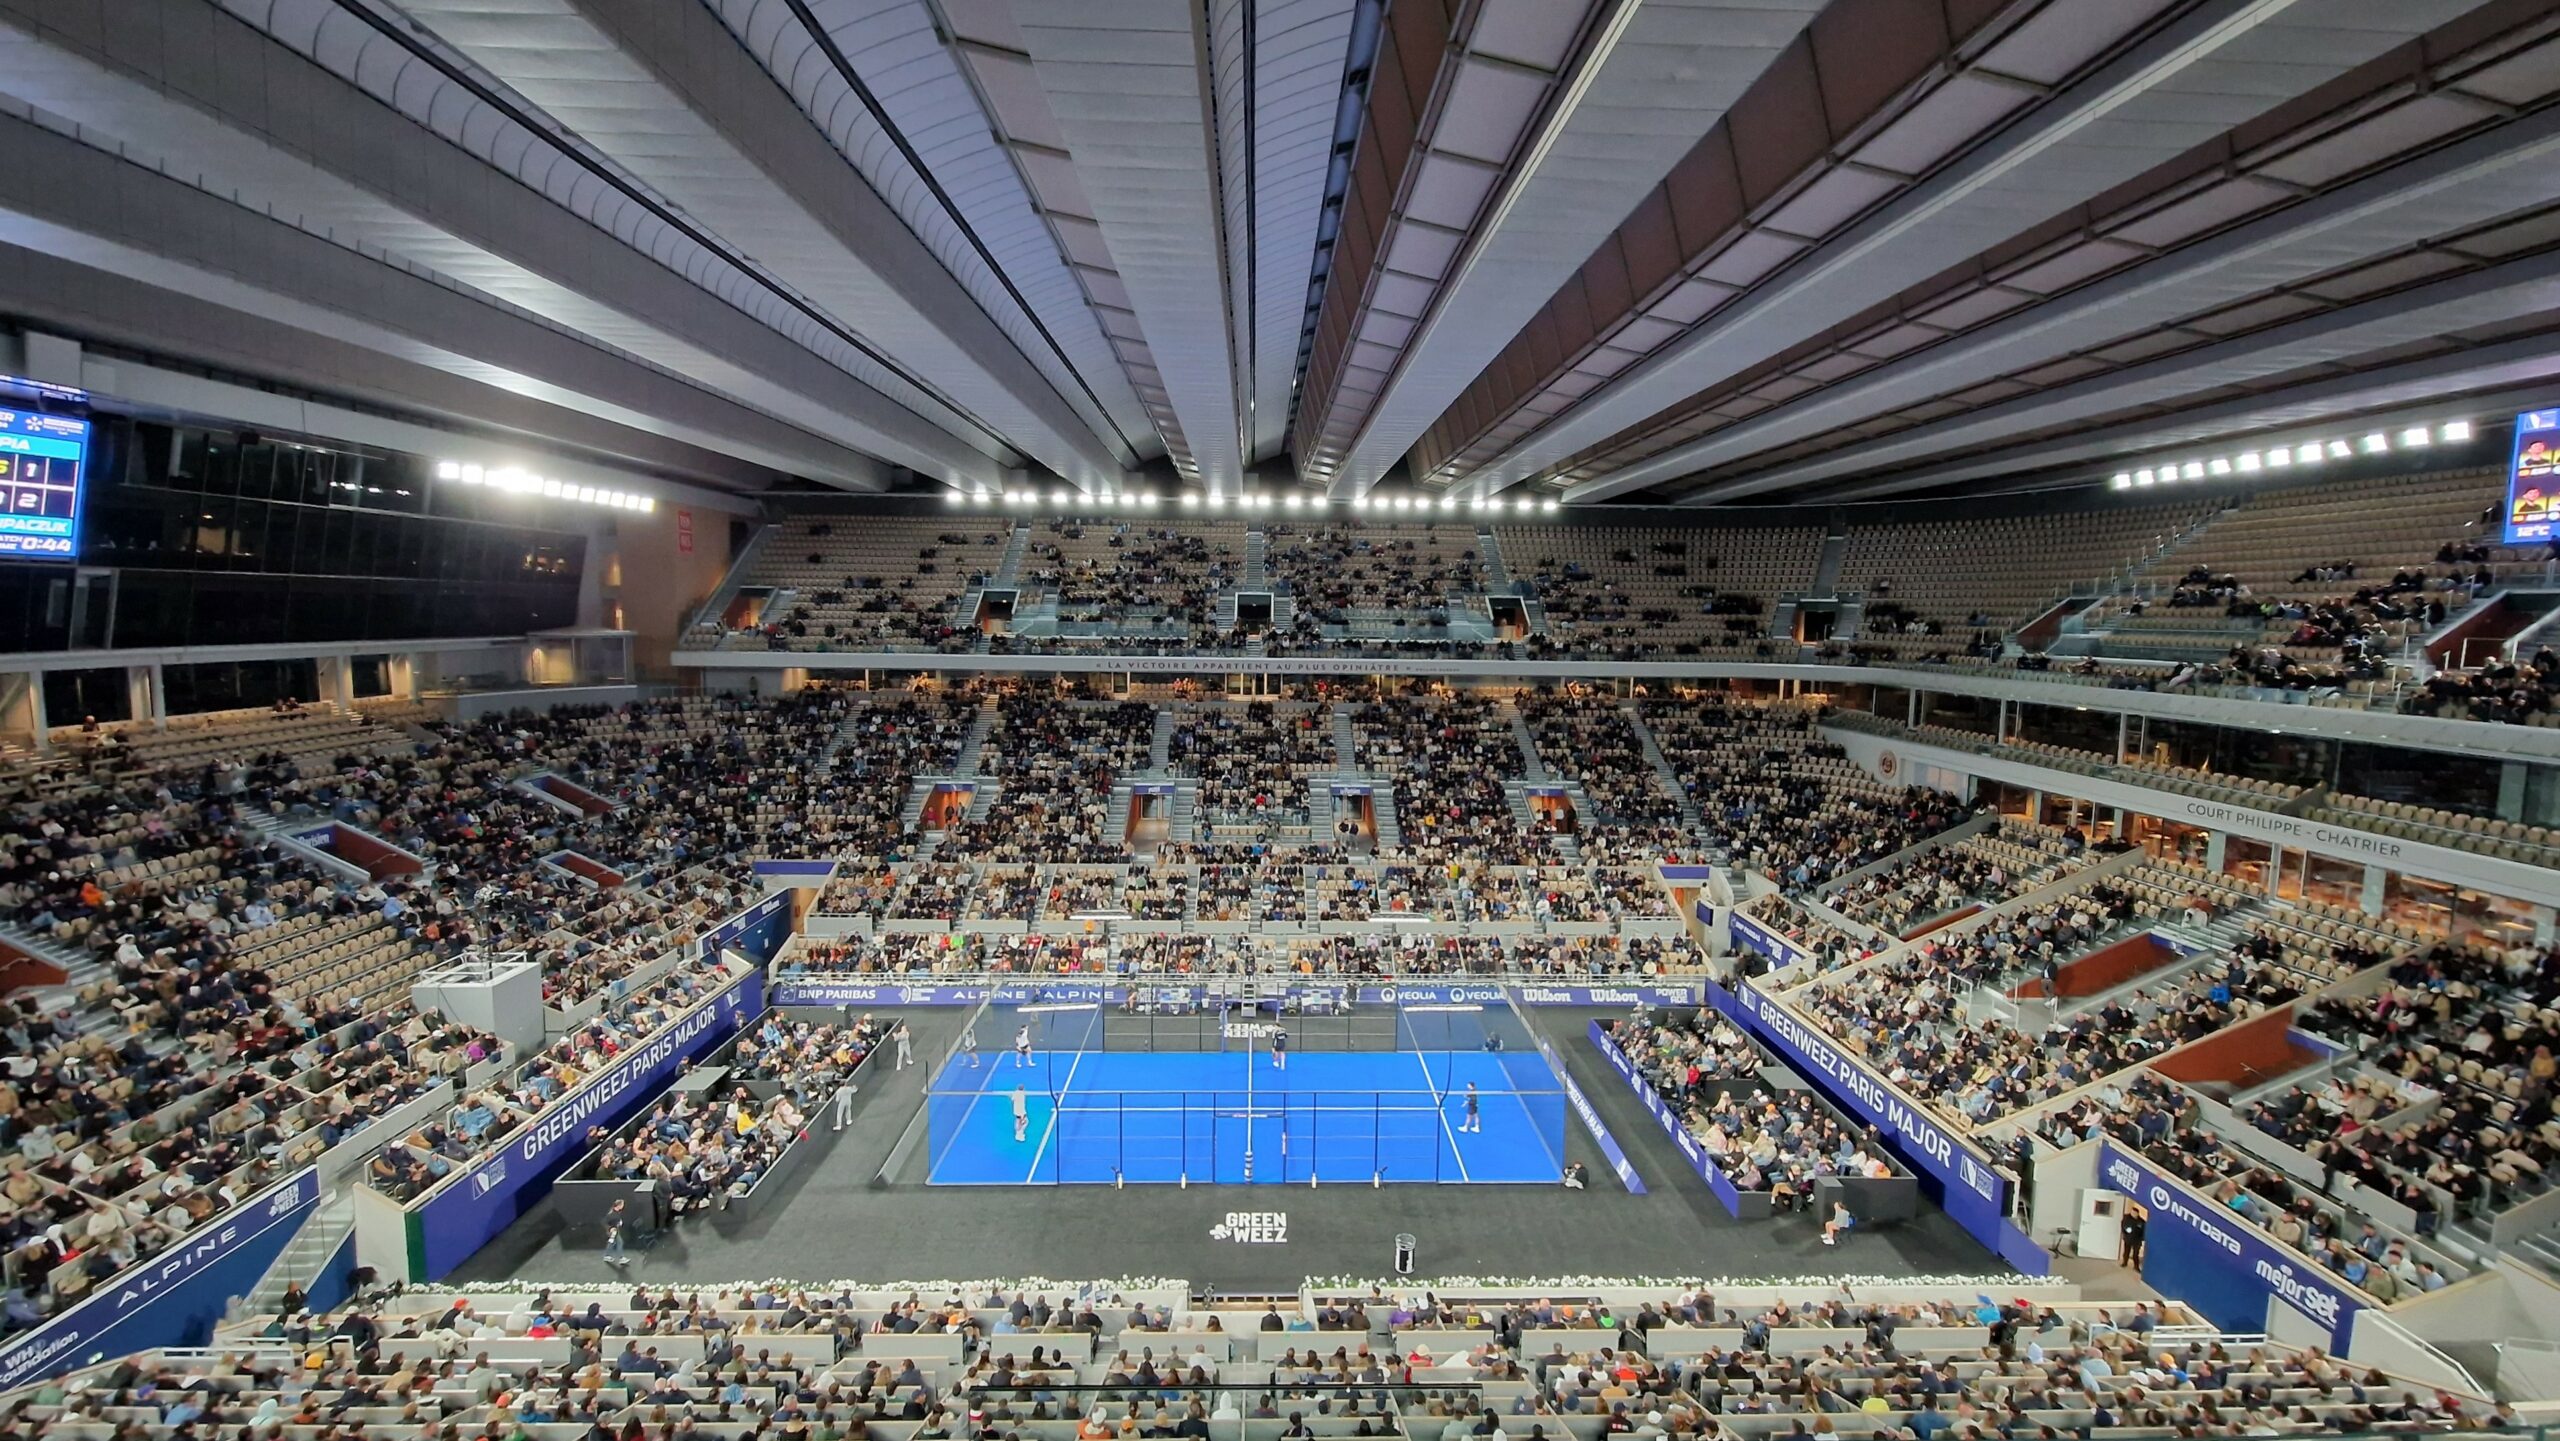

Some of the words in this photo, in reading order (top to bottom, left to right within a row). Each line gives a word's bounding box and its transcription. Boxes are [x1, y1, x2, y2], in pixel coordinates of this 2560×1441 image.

[27, 463, 37, 478] 1
[18, 493, 37, 508] 2
[21, 537, 72, 551] 0:44
[2186, 802, 2231, 821] COURT
[2236, 813, 2301, 836] PHILIPPE
[2316, 830, 2401, 857] CHATRIER
[798, 990, 824, 999] BNP
[825, 990, 876, 999] PARIBAS
[1044, 990, 1115, 999] ALPINE
[1398, 991, 1437, 1000] VEOLIA
[1466, 992, 1507, 1000] VEOLIA
[1522, 989, 1572, 1003] Wilson
[1590, 989, 1639, 1003] Wilson
[1655, 988, 1688, 997] POWER
[523, 1067, 630, 1160] GREENWEEZ
[633, 1042, 672, 1081] PARIS
[675, 1005, 716, 1049] MAJOR
[1760, 1001, 1837, 1077] GREENWEEZ
[1839, 1060, 1884, 1113] PARIS
[1888, 1099, 1952, 1168] MAJOR
[1225, 1212, 1287, 1227] GREEN
[1233, 1227, 1287, 1243] WEEZ
[117, 1226, 237, 1309] ALPINE
